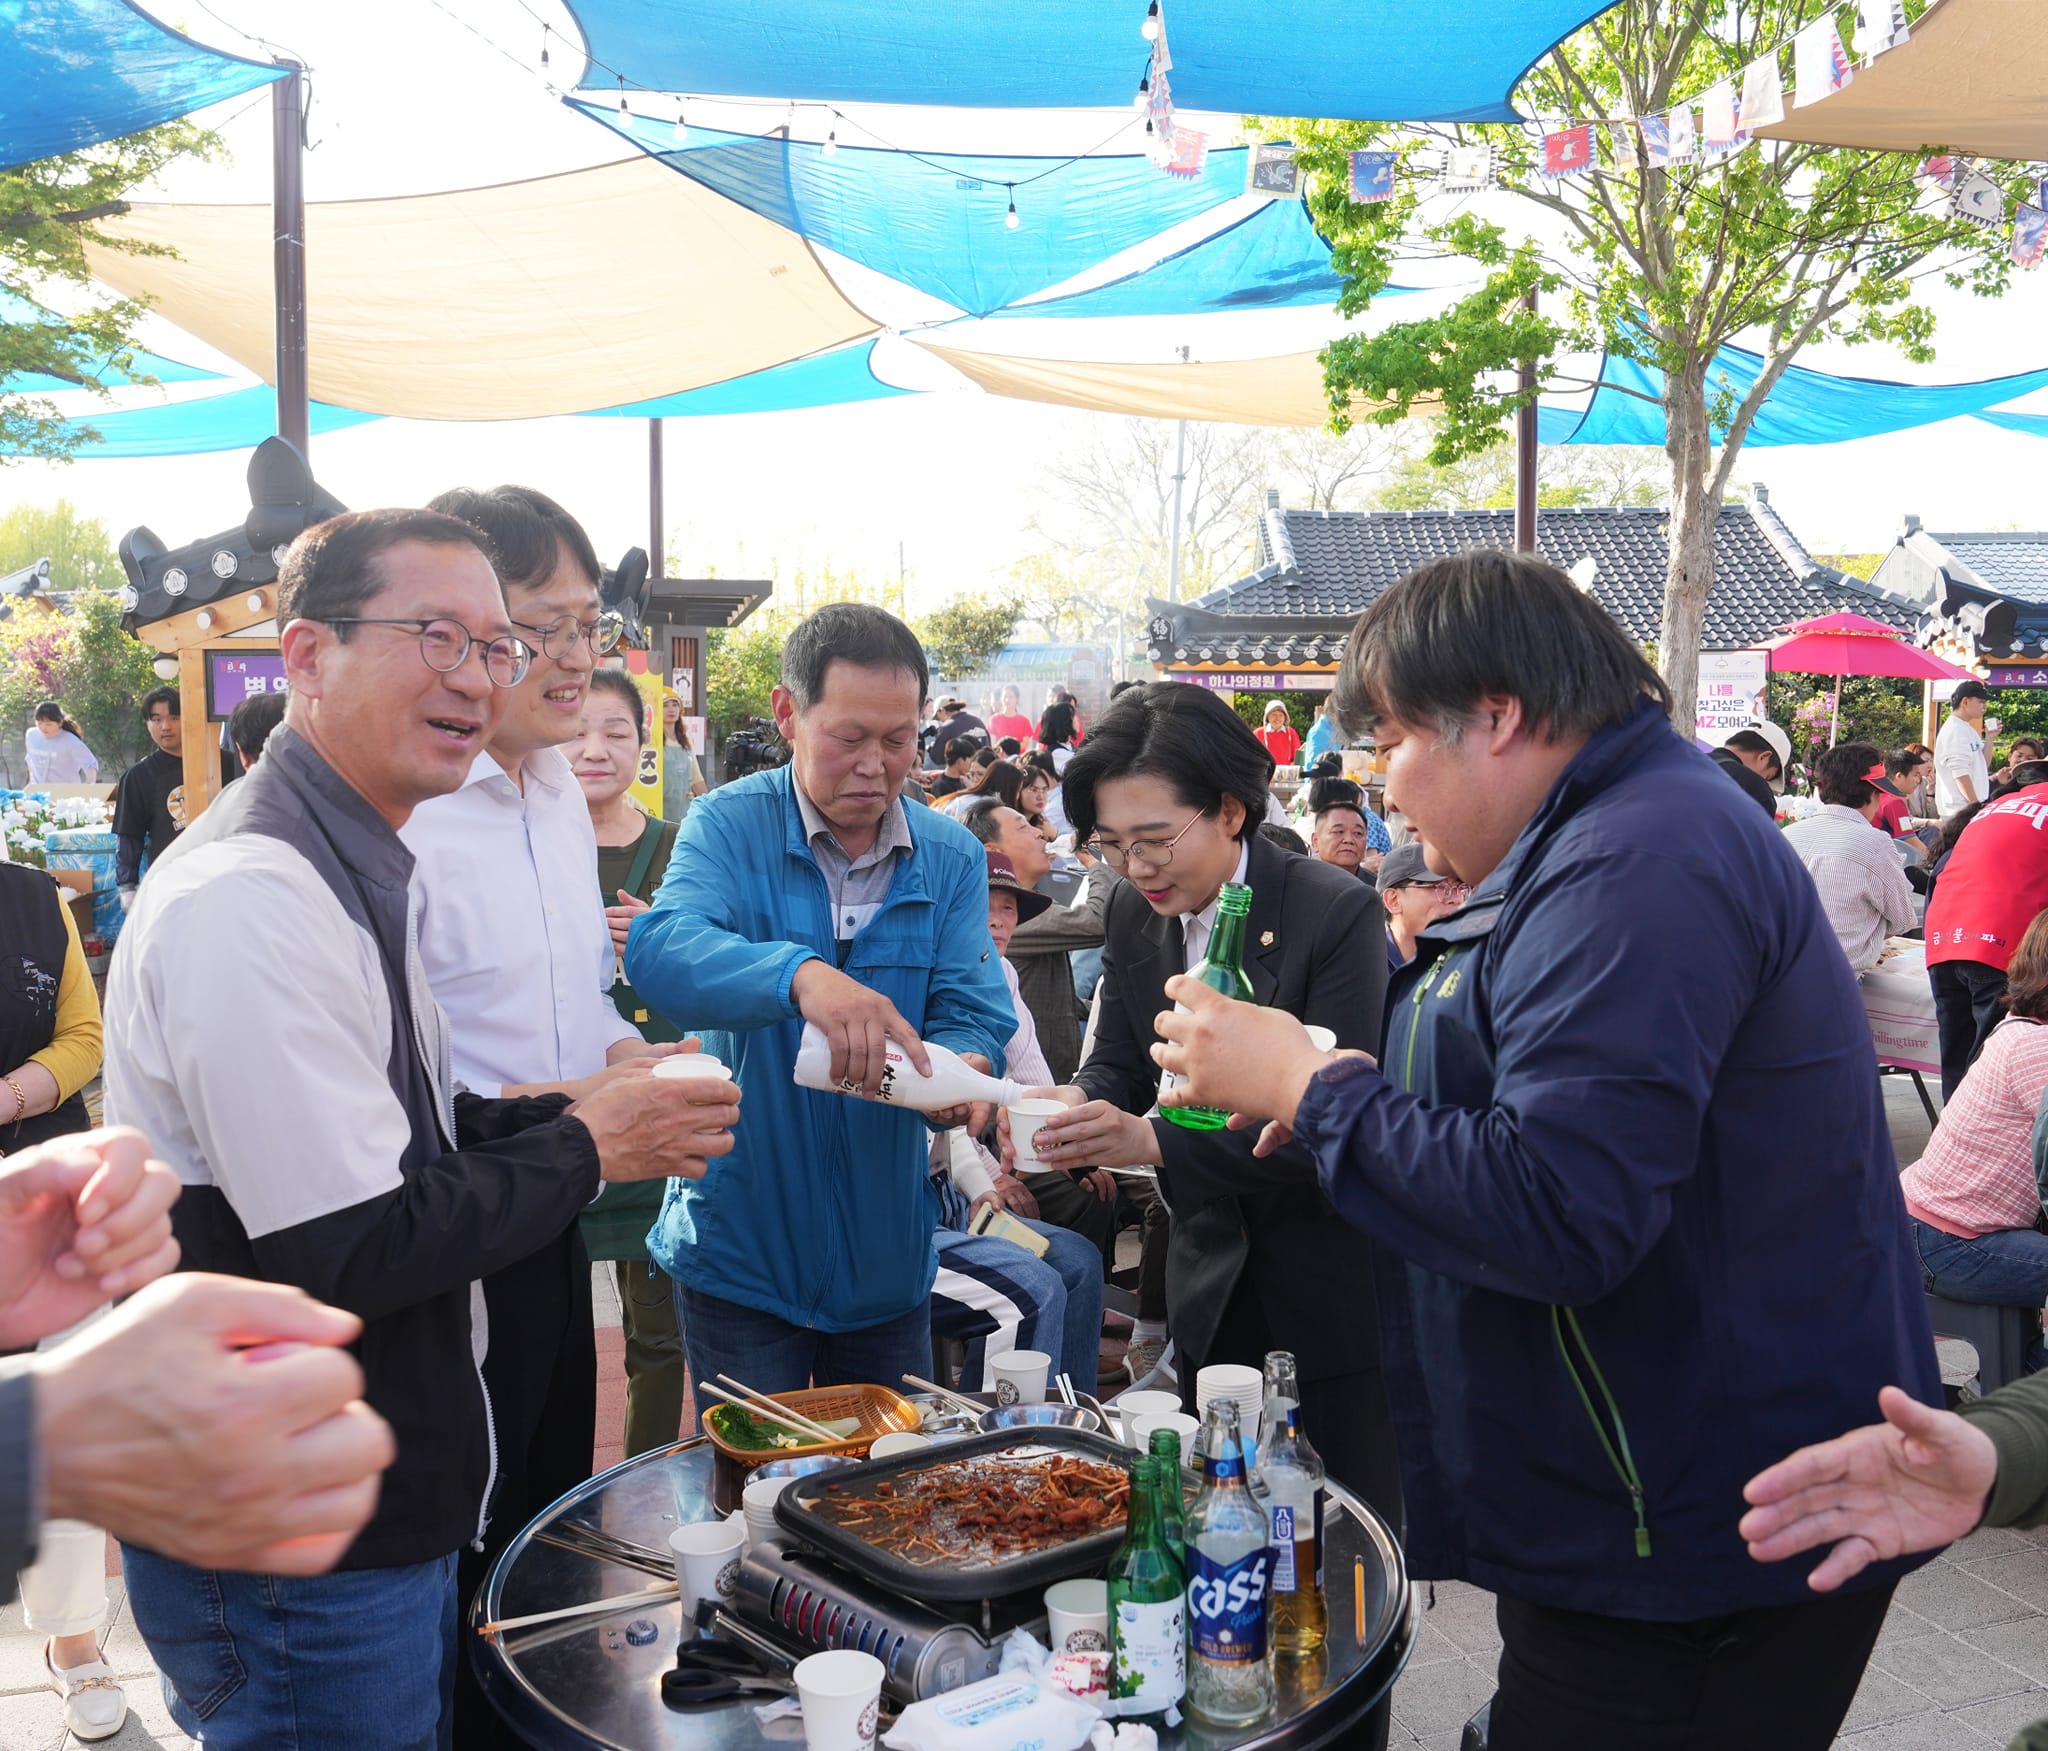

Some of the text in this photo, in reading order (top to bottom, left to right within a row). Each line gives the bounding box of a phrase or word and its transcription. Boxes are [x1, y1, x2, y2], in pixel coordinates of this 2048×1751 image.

[1152, 618, 1168, 635] 福
[1208, 674, 1276, 689] 하나의정원
[1709, 684, 1733, 697] 나를
